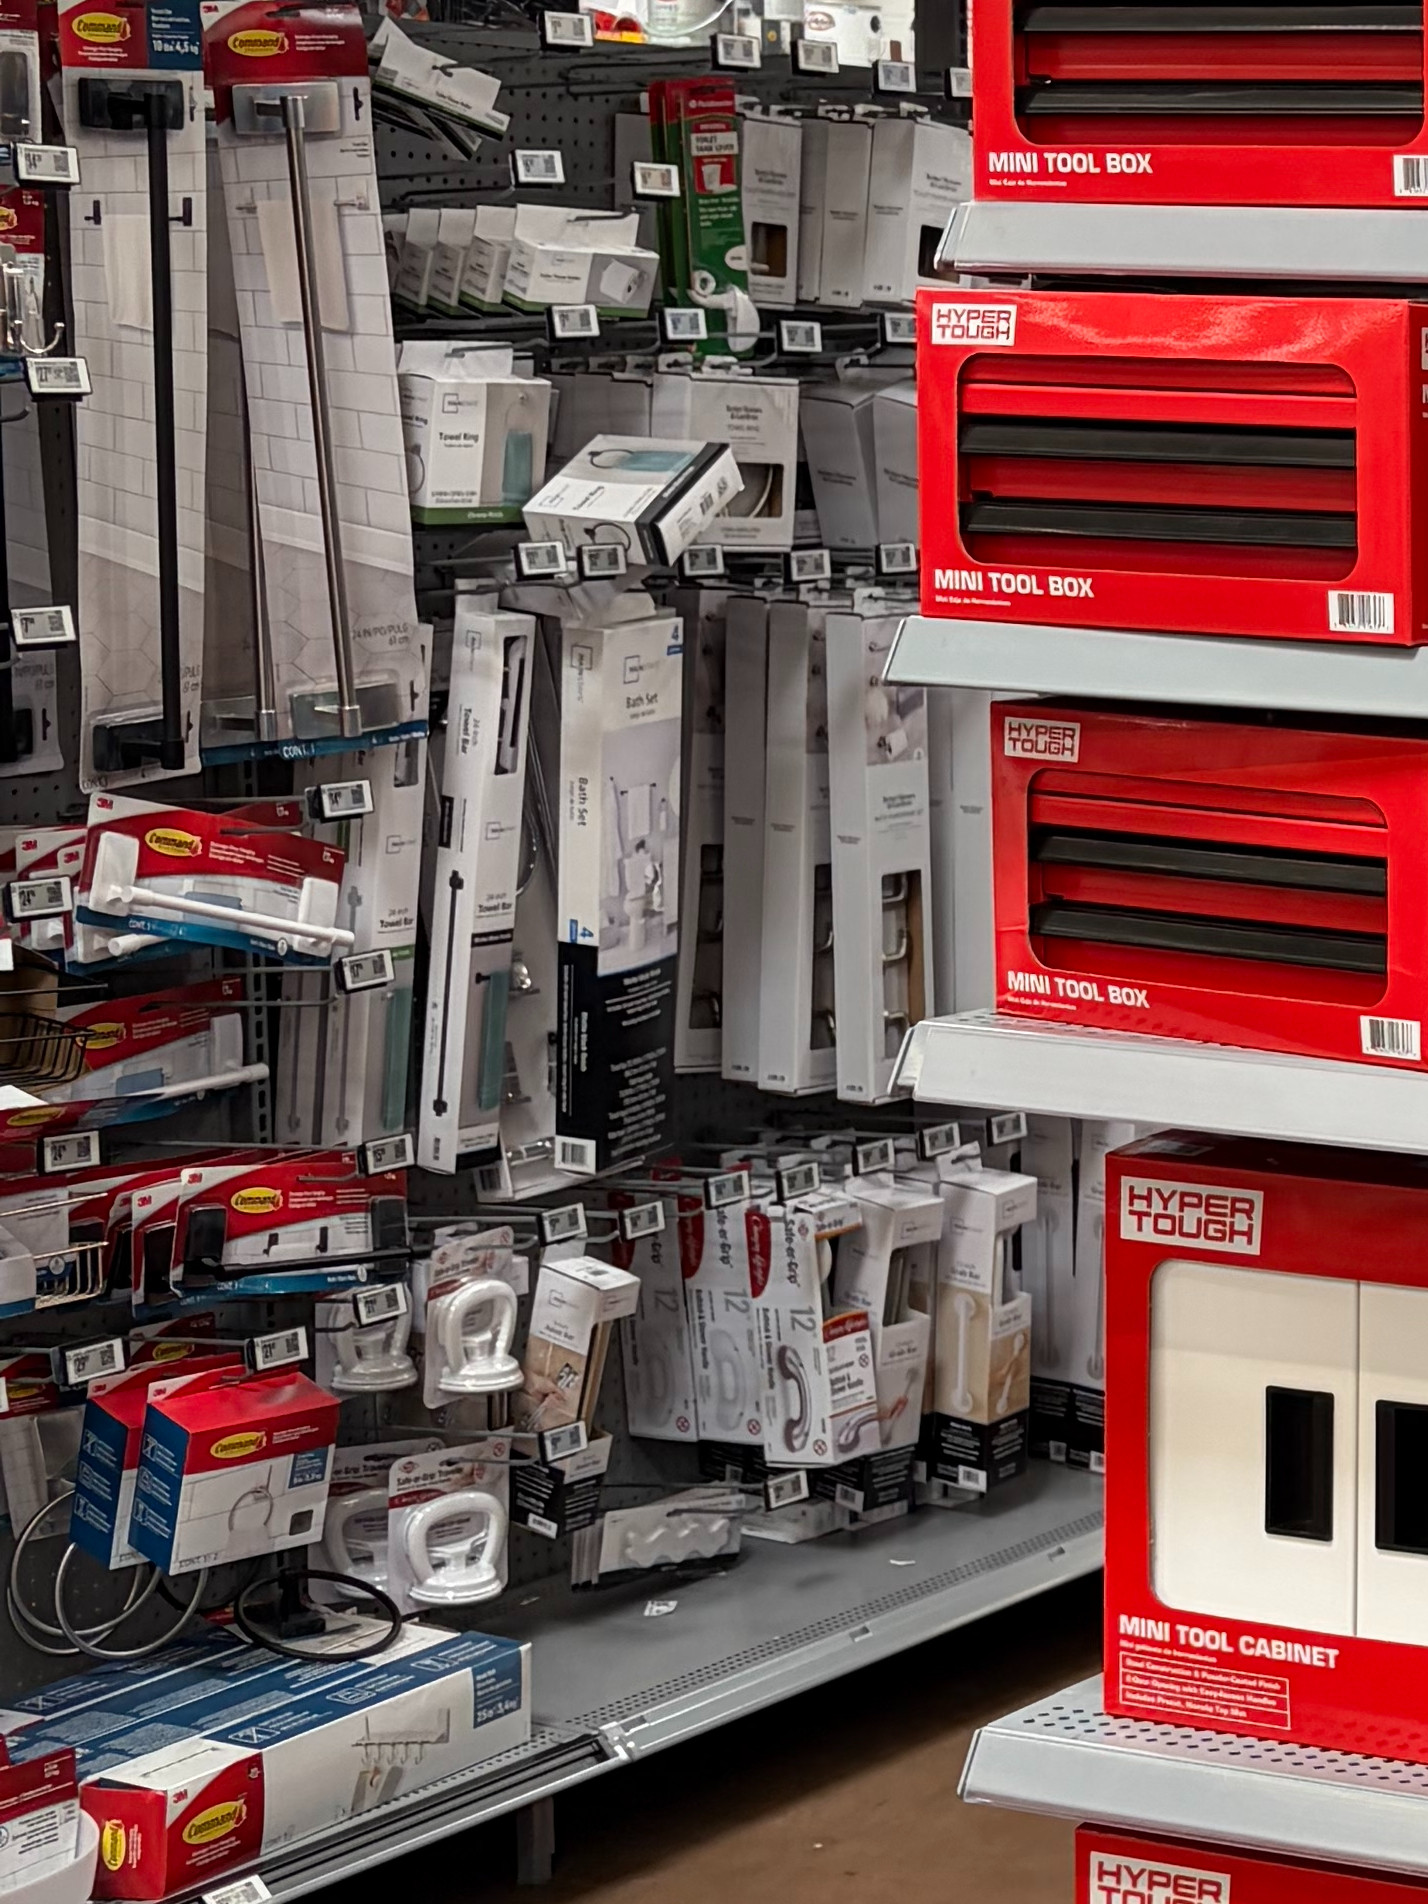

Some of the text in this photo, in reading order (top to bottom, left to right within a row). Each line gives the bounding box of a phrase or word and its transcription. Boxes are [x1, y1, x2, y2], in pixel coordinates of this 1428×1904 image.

[76, 18, 123, 34] Command
[232, 34, 280, 50] Command
[937, 308, 1013, 326] HYPER
[937, 323, 1012, 340] TOUGH
[438, 432, 479, 444] Towel Ring
[935, 569, 1094, 598] MINI TOOL BOX
[625, 692, 658, 710] Bath Set
[148, 832, 196, 849] Command
[1128, 1184, 1256, 1223] HYPER
[1128, 1208, 1254, 1247] TOUGH
[1120, 1614, 1339, 1669] MINI TOOL CABINET
[188, 1808, 236, 1839] Command
[1097, 1860, 1222, 1904] HYPER
